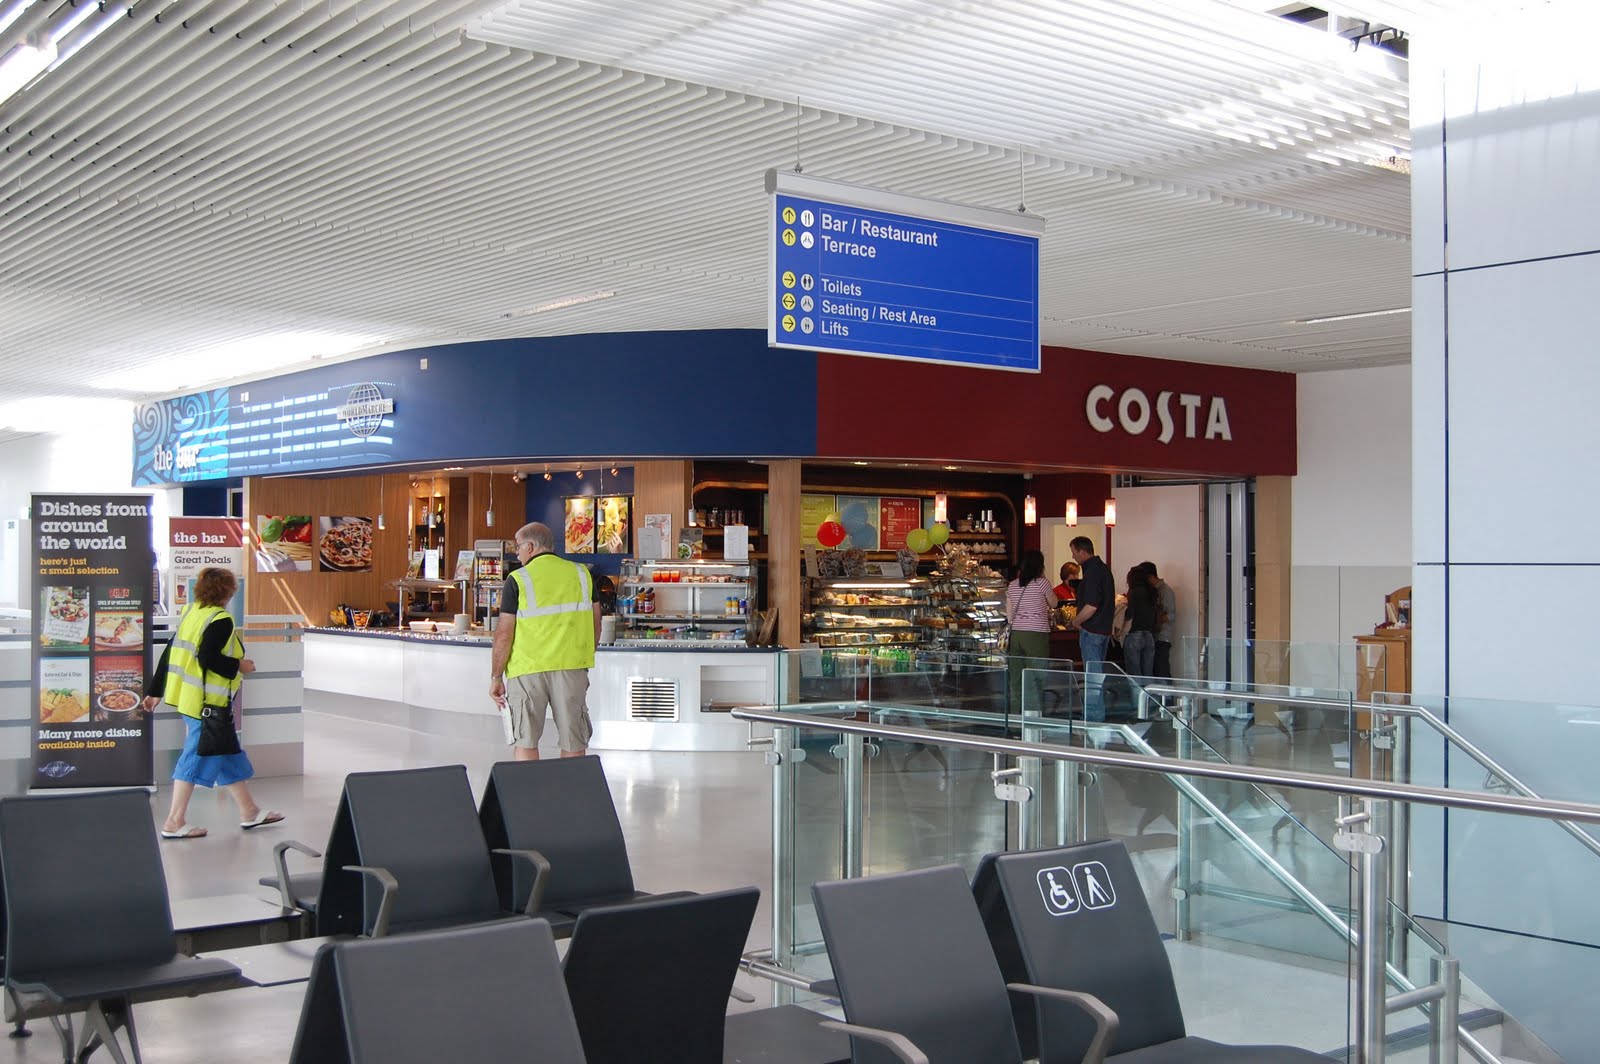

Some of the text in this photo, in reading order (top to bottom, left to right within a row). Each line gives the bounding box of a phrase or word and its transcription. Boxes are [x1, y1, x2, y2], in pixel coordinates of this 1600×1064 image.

[822, 213, 938, 247] Bar / Restaurant
[821, 235, 877, 258] Terrace
[821, 278, 862, 297] Toilets
[822, 300, 937, 326] Seating / Rest Area
[821, 320, 849, 336] Lifts
[1086, 384, 1232, 444] COSTA
[153, 442, 200, 471] the bar
[40, 502, 148, 516] Dishes from
[40, 519, 108, 533] around
[40, 536, 127, 550] the world
[174, 532, 226, 543] the bar
[40, 558, 87, 567] here's just
[174, 556, 232, 564] Great Deals
[49, 567, 75, 575] small
[77, 567, 119, 575] selection
[39, 728, 142, 740] Many more dishes
[39, 741, 85, 750] available
